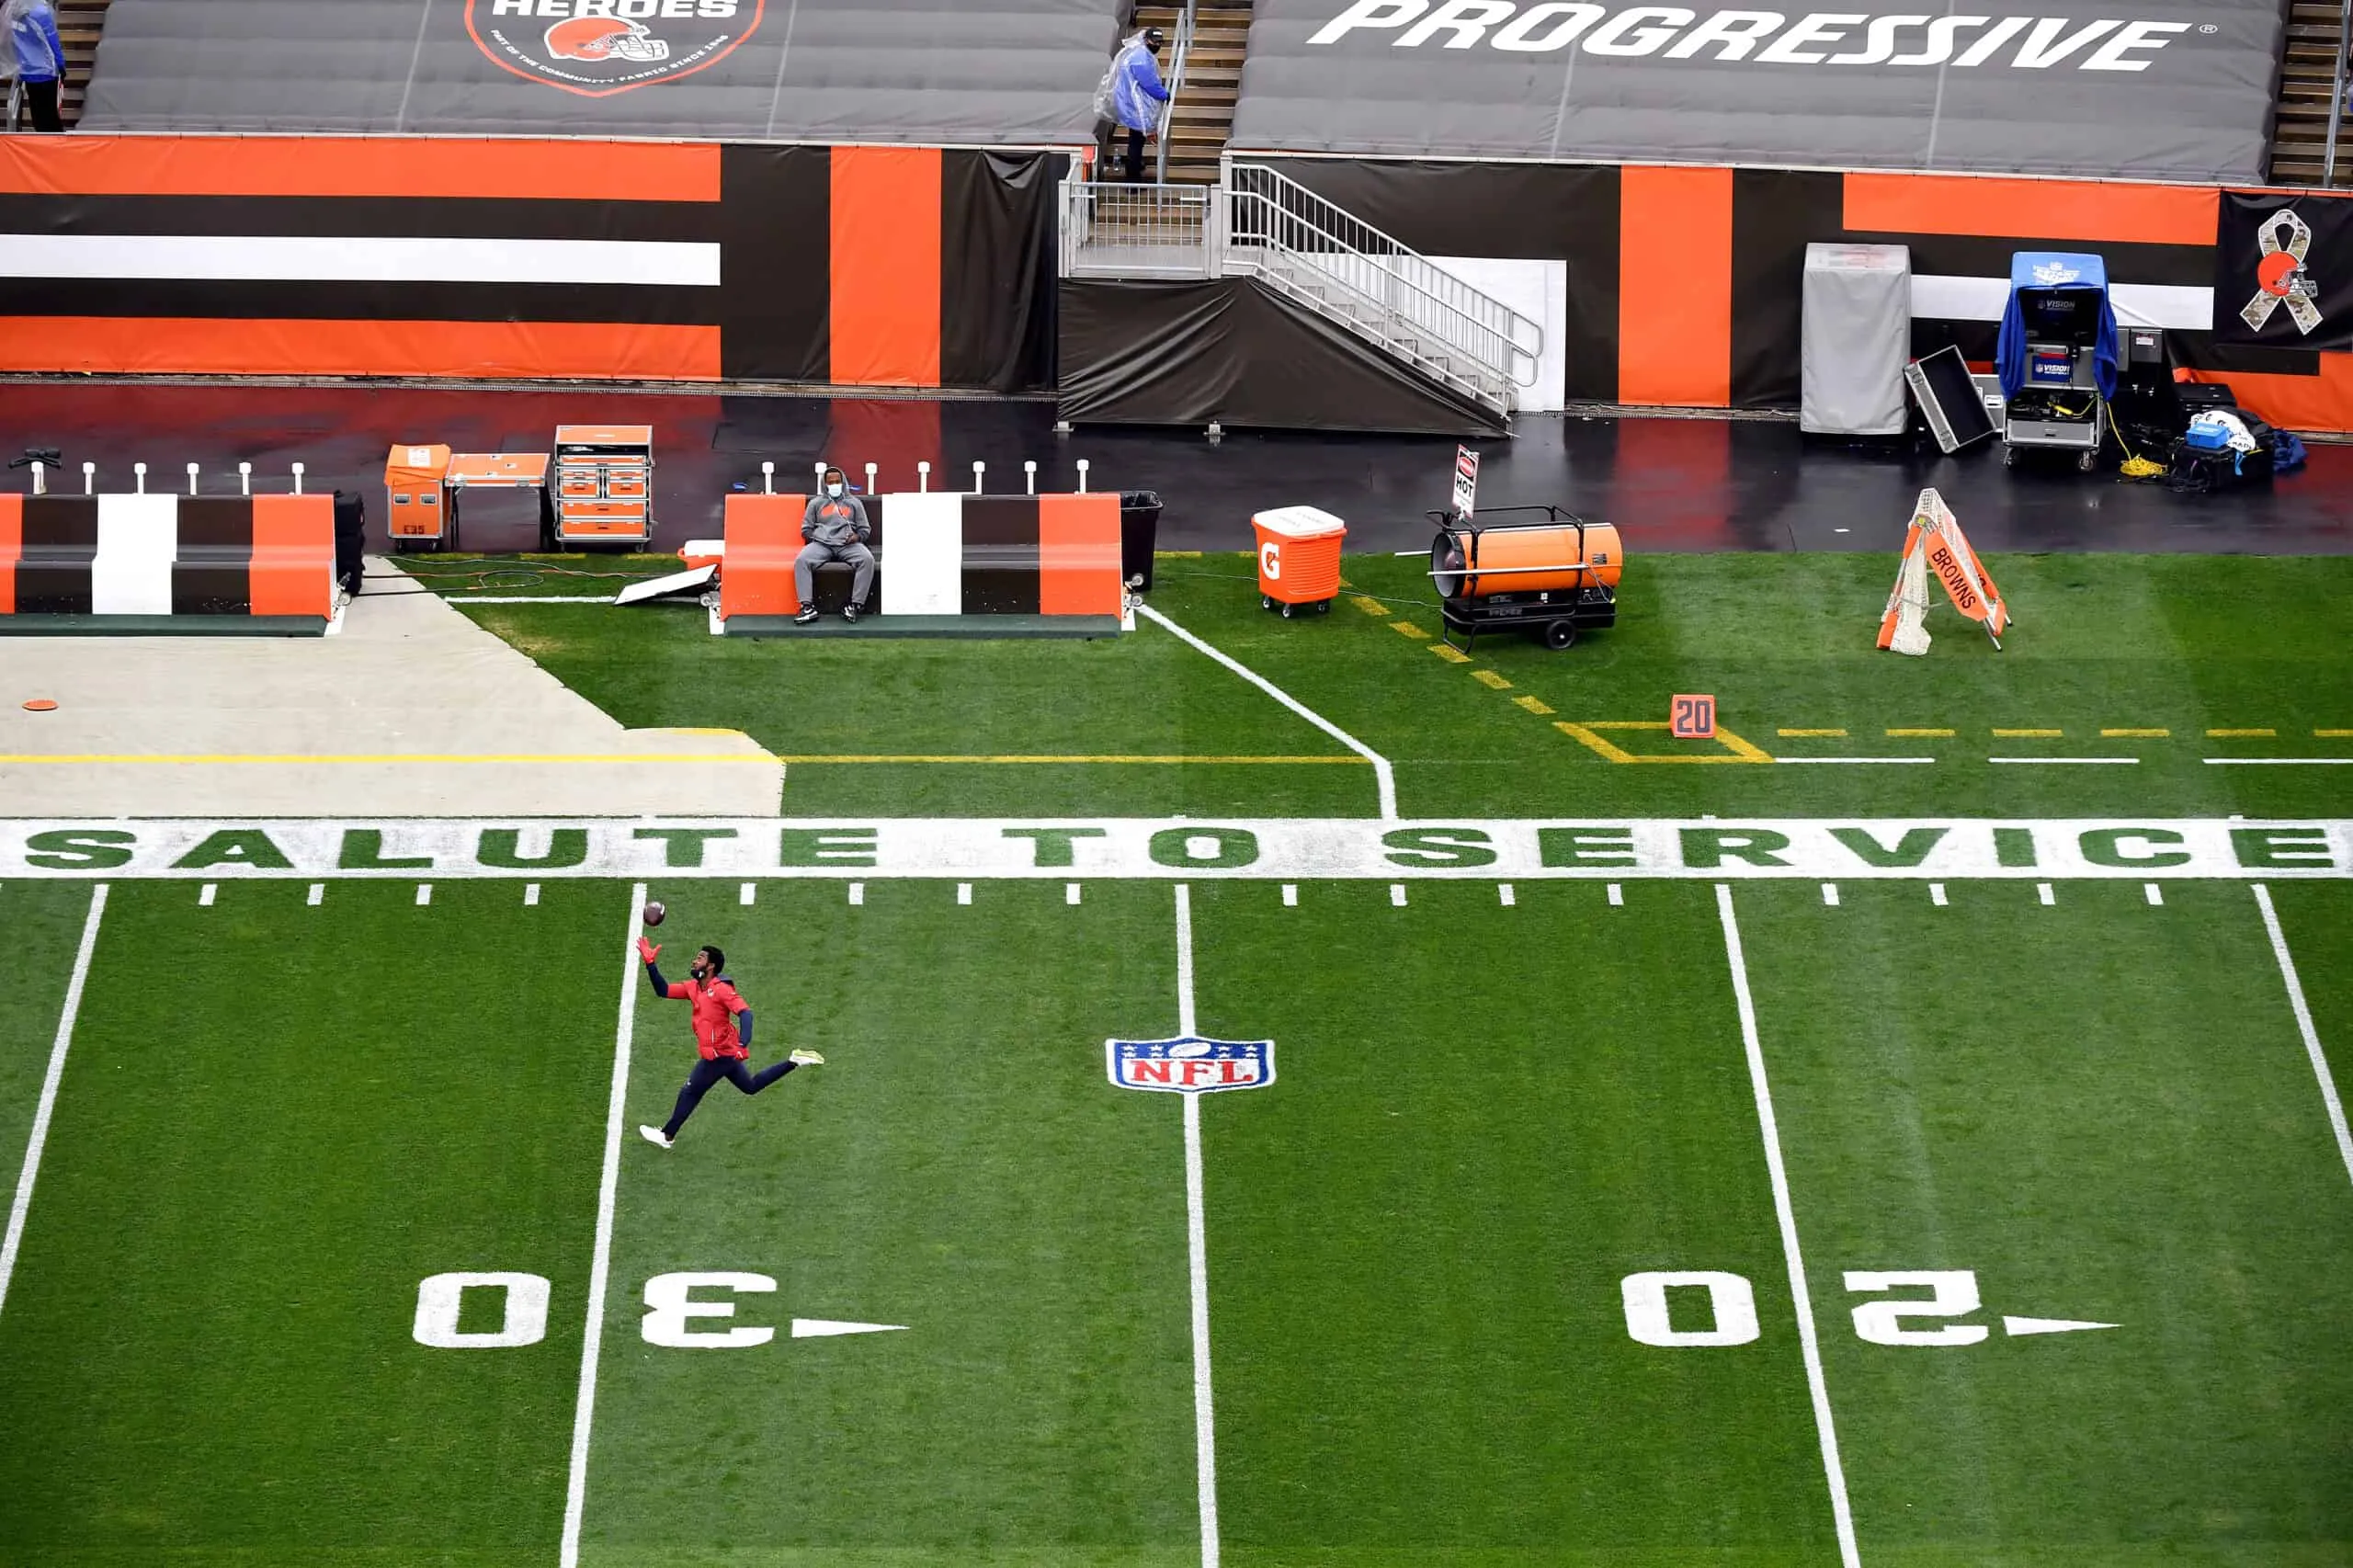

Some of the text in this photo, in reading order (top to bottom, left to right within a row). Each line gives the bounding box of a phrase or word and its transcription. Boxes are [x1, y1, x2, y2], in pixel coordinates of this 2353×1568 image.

[492, 0, 737, 17] HEROES
[1305, 0, 2191, 72] PROGRESSIVE
[2046, 300, 2075, 309] VISION
[2044, 364, 2071, 372] VISION
[1456, 474, 1473, 497] HOT
[1261, 541, 1280, 580] G
[1932, 547, 1976, 608] BROWNS
[1677, 699, 1711, 733] 20
[25, 827, 2335, 869] SALUTE TO SERVICE
[1130, 1059, 1254, 1085] NFL
